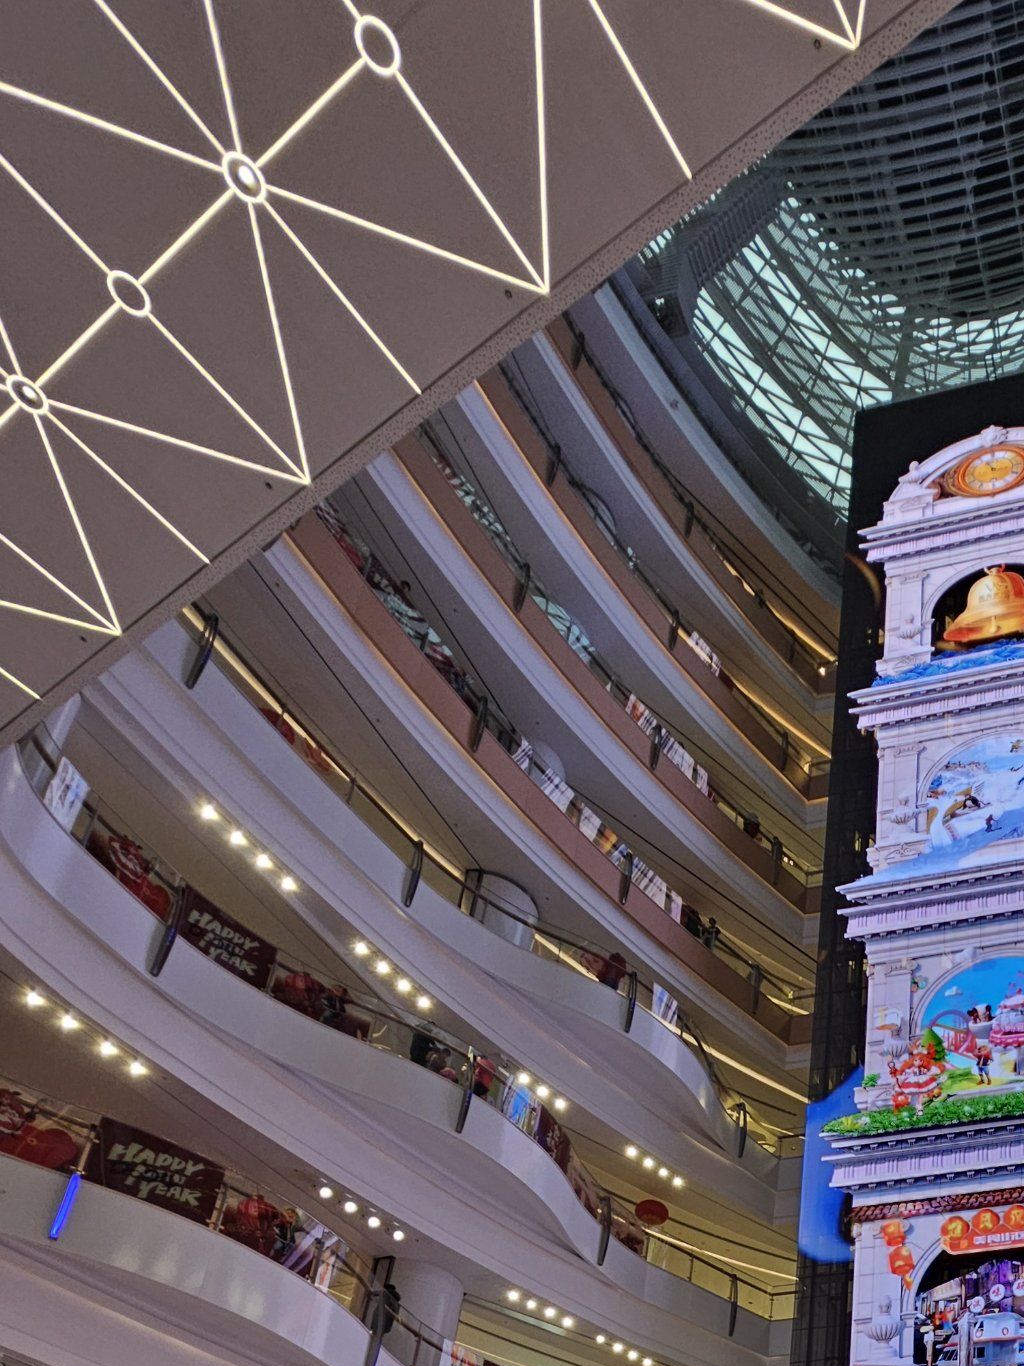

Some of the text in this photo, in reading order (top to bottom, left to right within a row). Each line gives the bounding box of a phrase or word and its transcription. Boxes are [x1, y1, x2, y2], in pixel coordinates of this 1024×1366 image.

[187, 909, 260, 951] HAPPY
[107, 1142, 206, 1176] HAPPY
[137, 1181, 202, 1207] YEAR
